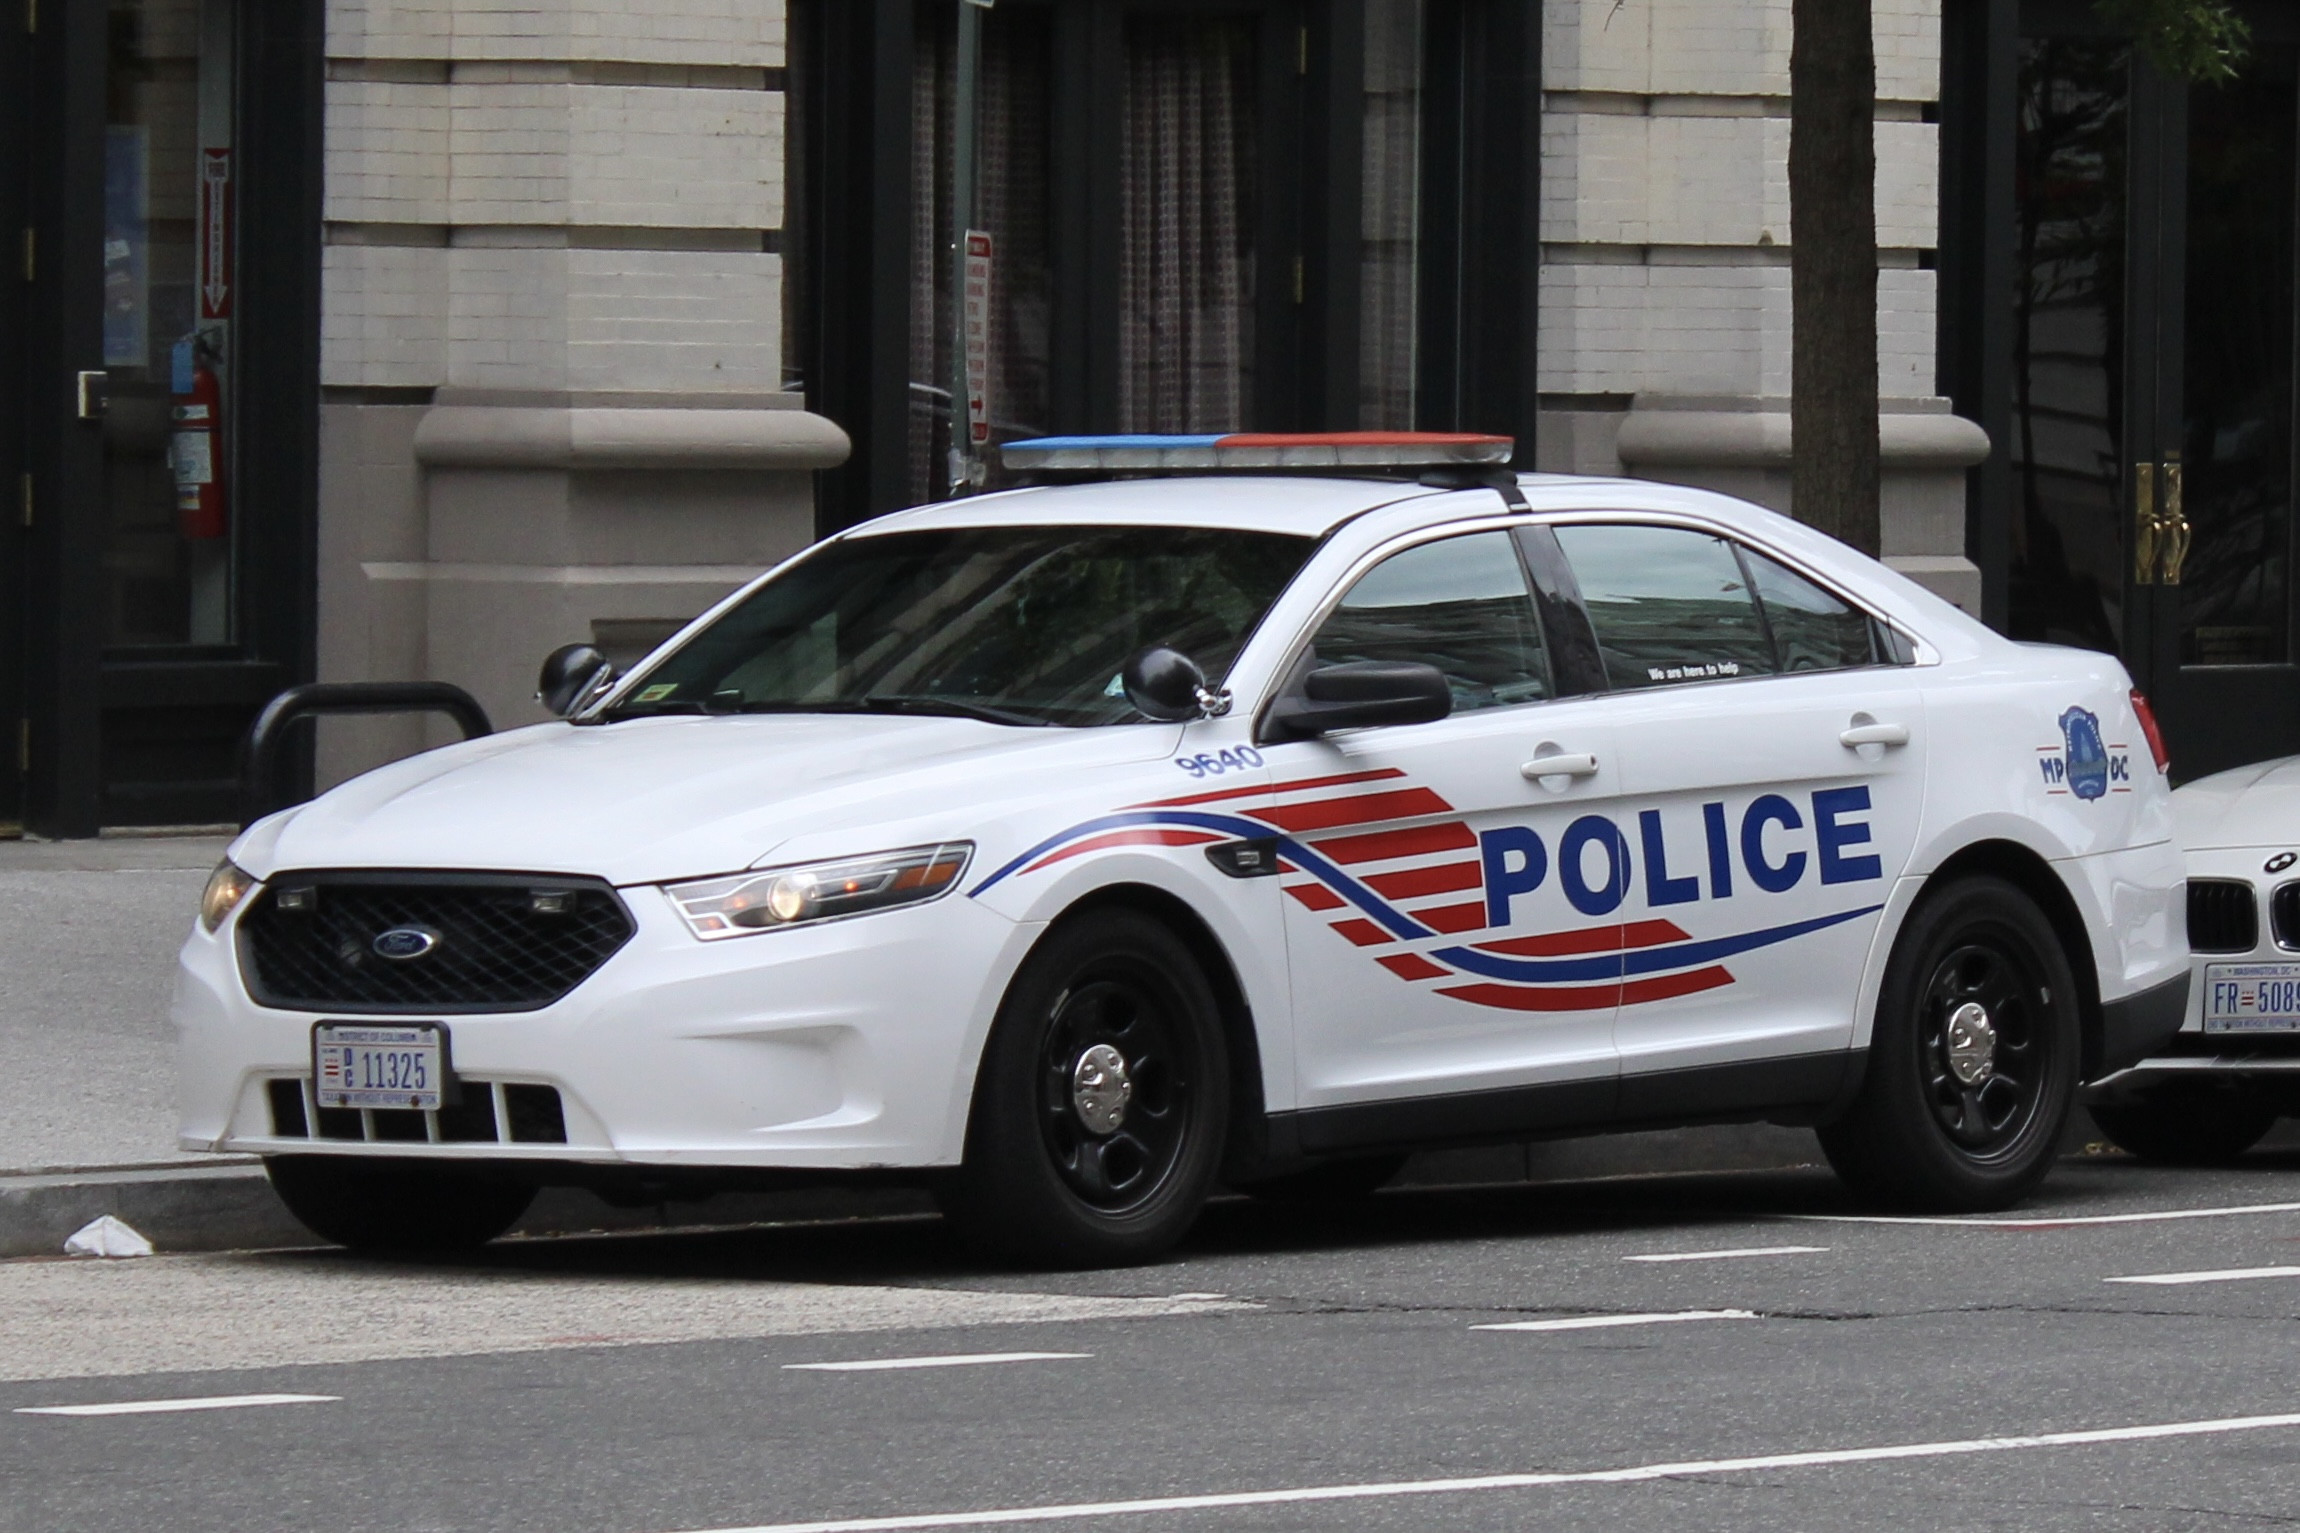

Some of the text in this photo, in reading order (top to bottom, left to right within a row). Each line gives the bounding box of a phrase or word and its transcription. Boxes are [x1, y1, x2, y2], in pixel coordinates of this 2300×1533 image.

[1648, 661, 1739, 681] We are here to help
[1175, 744, 1264, 778] 9640
[2039, 755, 2129, 783] MP DC
[1480, 785, 1882, 928] POLICE
[2215, 982, 2238, 1014] FR
[362, 1051, 426, 1089] 11325
